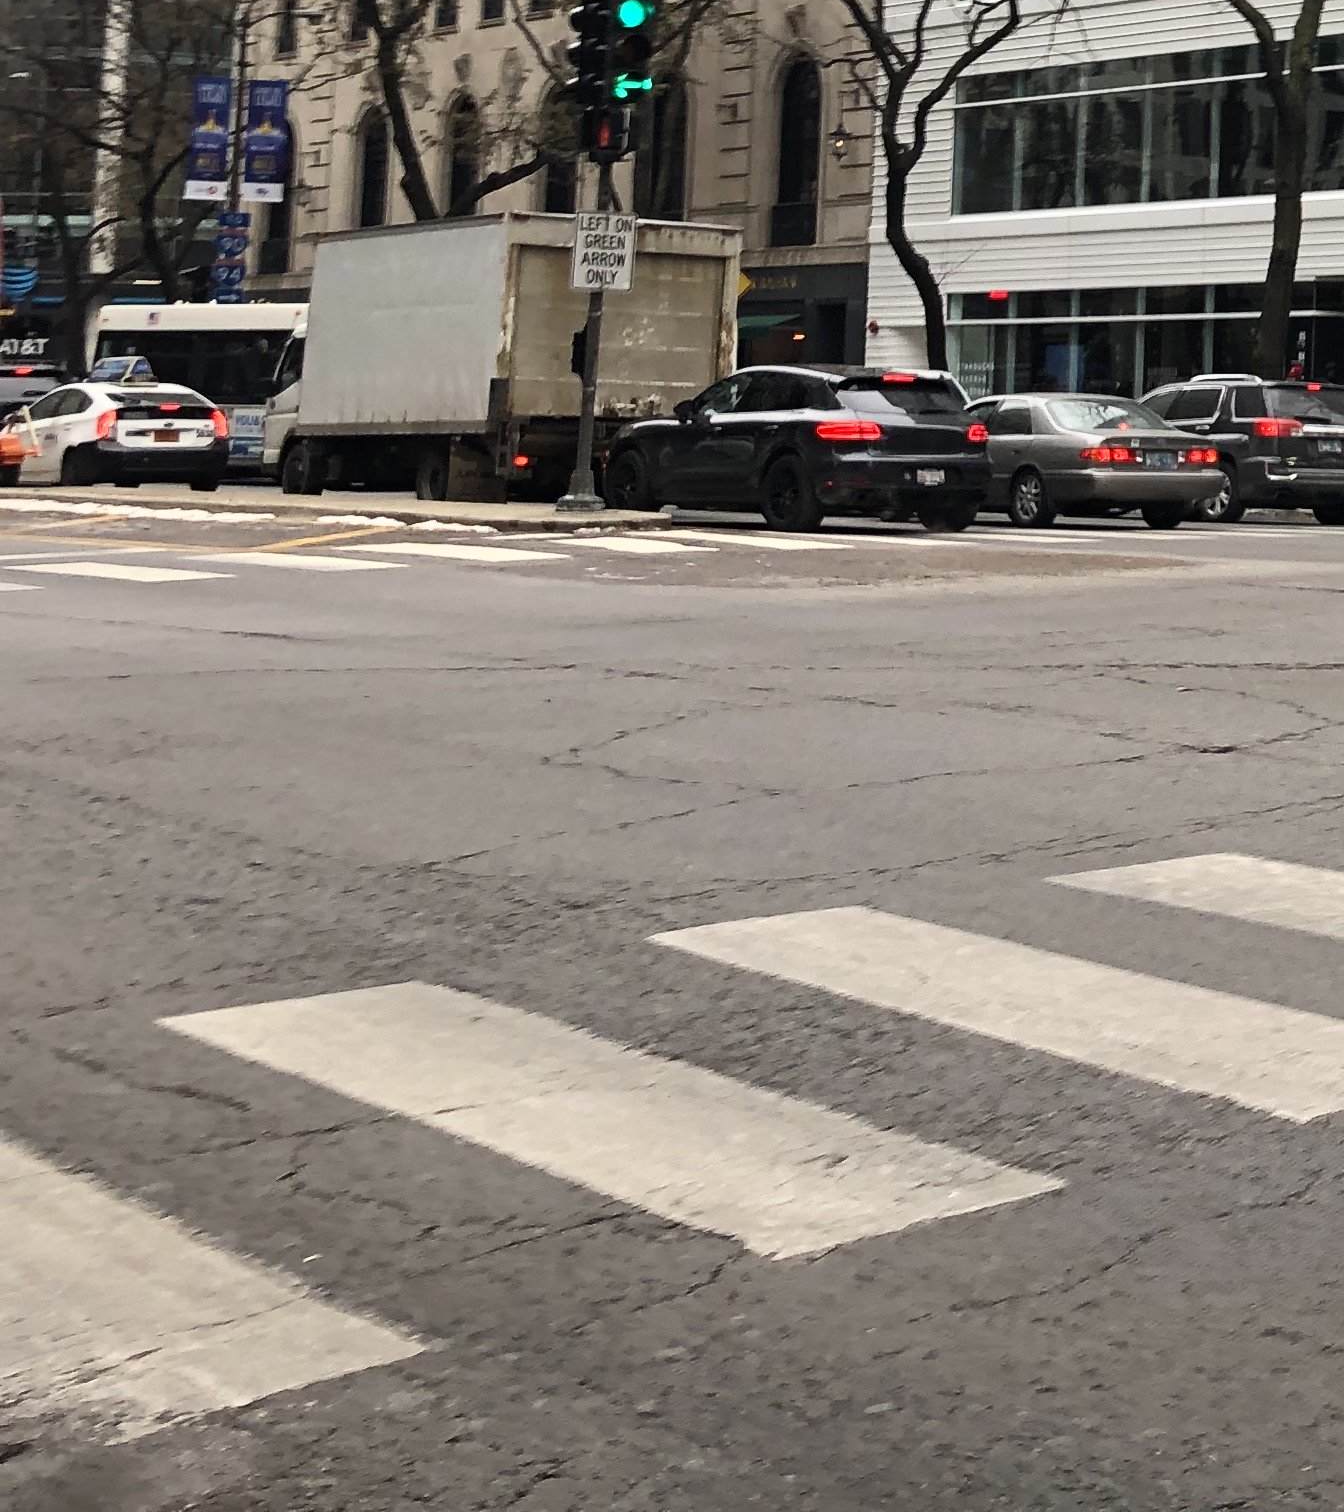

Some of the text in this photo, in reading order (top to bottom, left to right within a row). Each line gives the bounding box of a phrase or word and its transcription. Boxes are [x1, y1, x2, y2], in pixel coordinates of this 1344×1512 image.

[580, 216, 633, 233] LEFT ON
[585, 234, 626, 250] GREEN
[580, 251, 626, 267] ARROW
[585, 268, 618, 284] ONLY
[0, 338, 49, 355] AT&T
